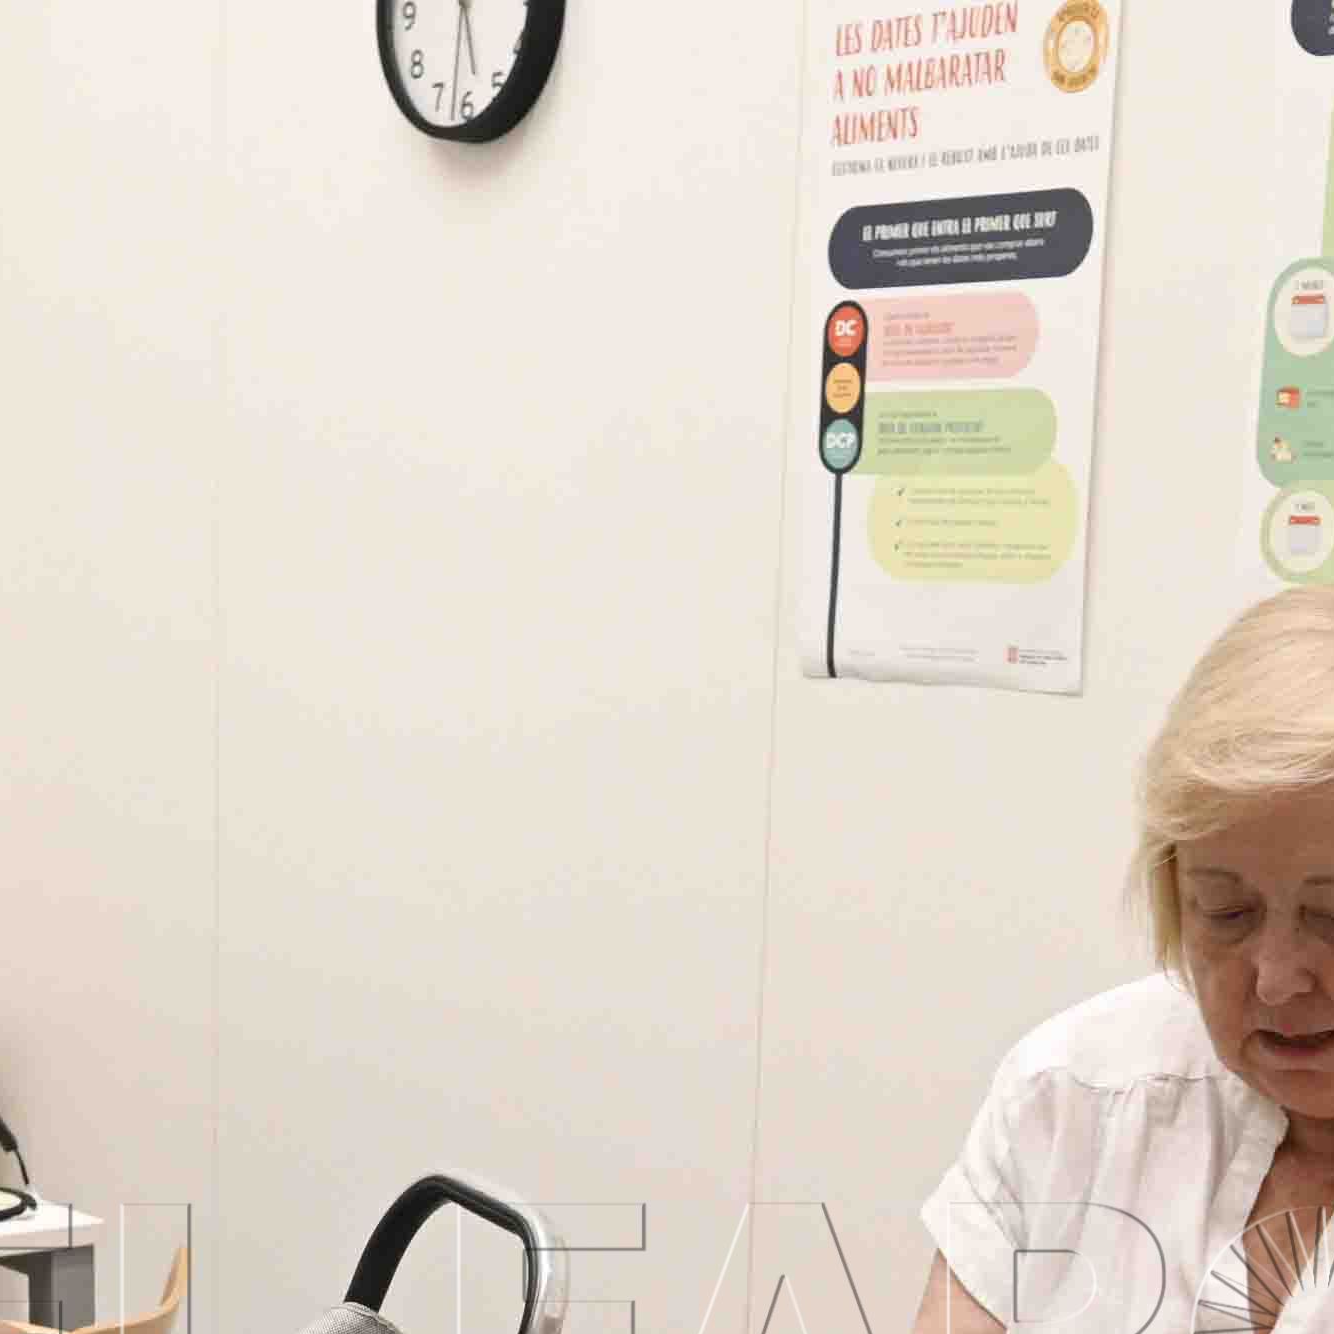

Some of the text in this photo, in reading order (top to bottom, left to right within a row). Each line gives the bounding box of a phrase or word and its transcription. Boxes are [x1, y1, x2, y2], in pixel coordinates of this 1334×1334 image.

[402, 2, 417, 30] 9
[835, 23, 863, 57] LES
[870, 14, 923, 53] DATES
[932, 1, 1019, 44] T'AJUDEN
[410, 49, 425, 79] 8
[832, 48, 1007, 101] A NO MALBARATAR
[431, 82, 446, 112] 7
[460, 91, 475, 121] 6
[831, 106, 919, 147] ALIMENTS
[834, 319, 858, 337] DC
